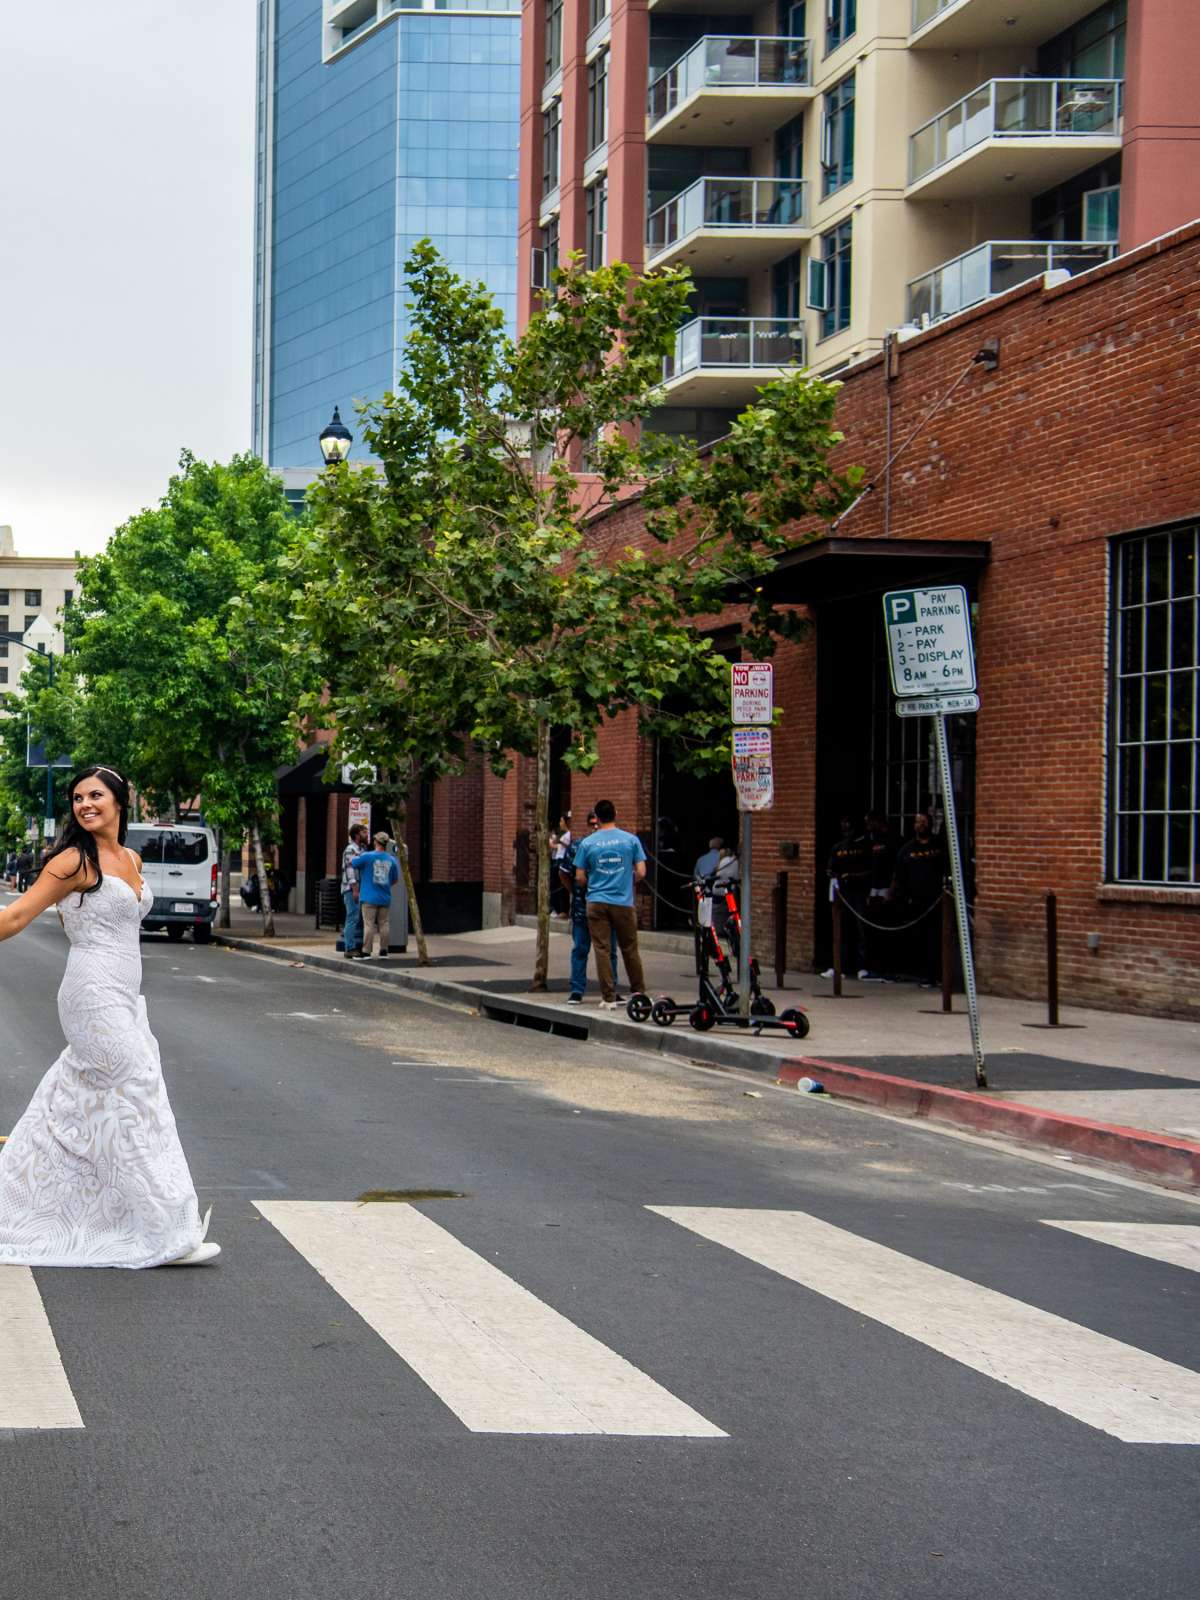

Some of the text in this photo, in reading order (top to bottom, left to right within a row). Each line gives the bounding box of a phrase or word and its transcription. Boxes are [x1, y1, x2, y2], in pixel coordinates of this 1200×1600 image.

[931, 593, 947, 604] PAY
[891, 598, 911, 621] P
[920, 604, 961, 617] PARKING
[915, 624, 945, 637] PARK
[897, 642, 905, 653] 2
[916, 639, 937, 649] PAY
[899, 655, 907, 666] 3
[918, 650, 964, 663] DISPLAY
[734, 671, 748, 685] NO
[734, 688, 769, 698] PARKING
